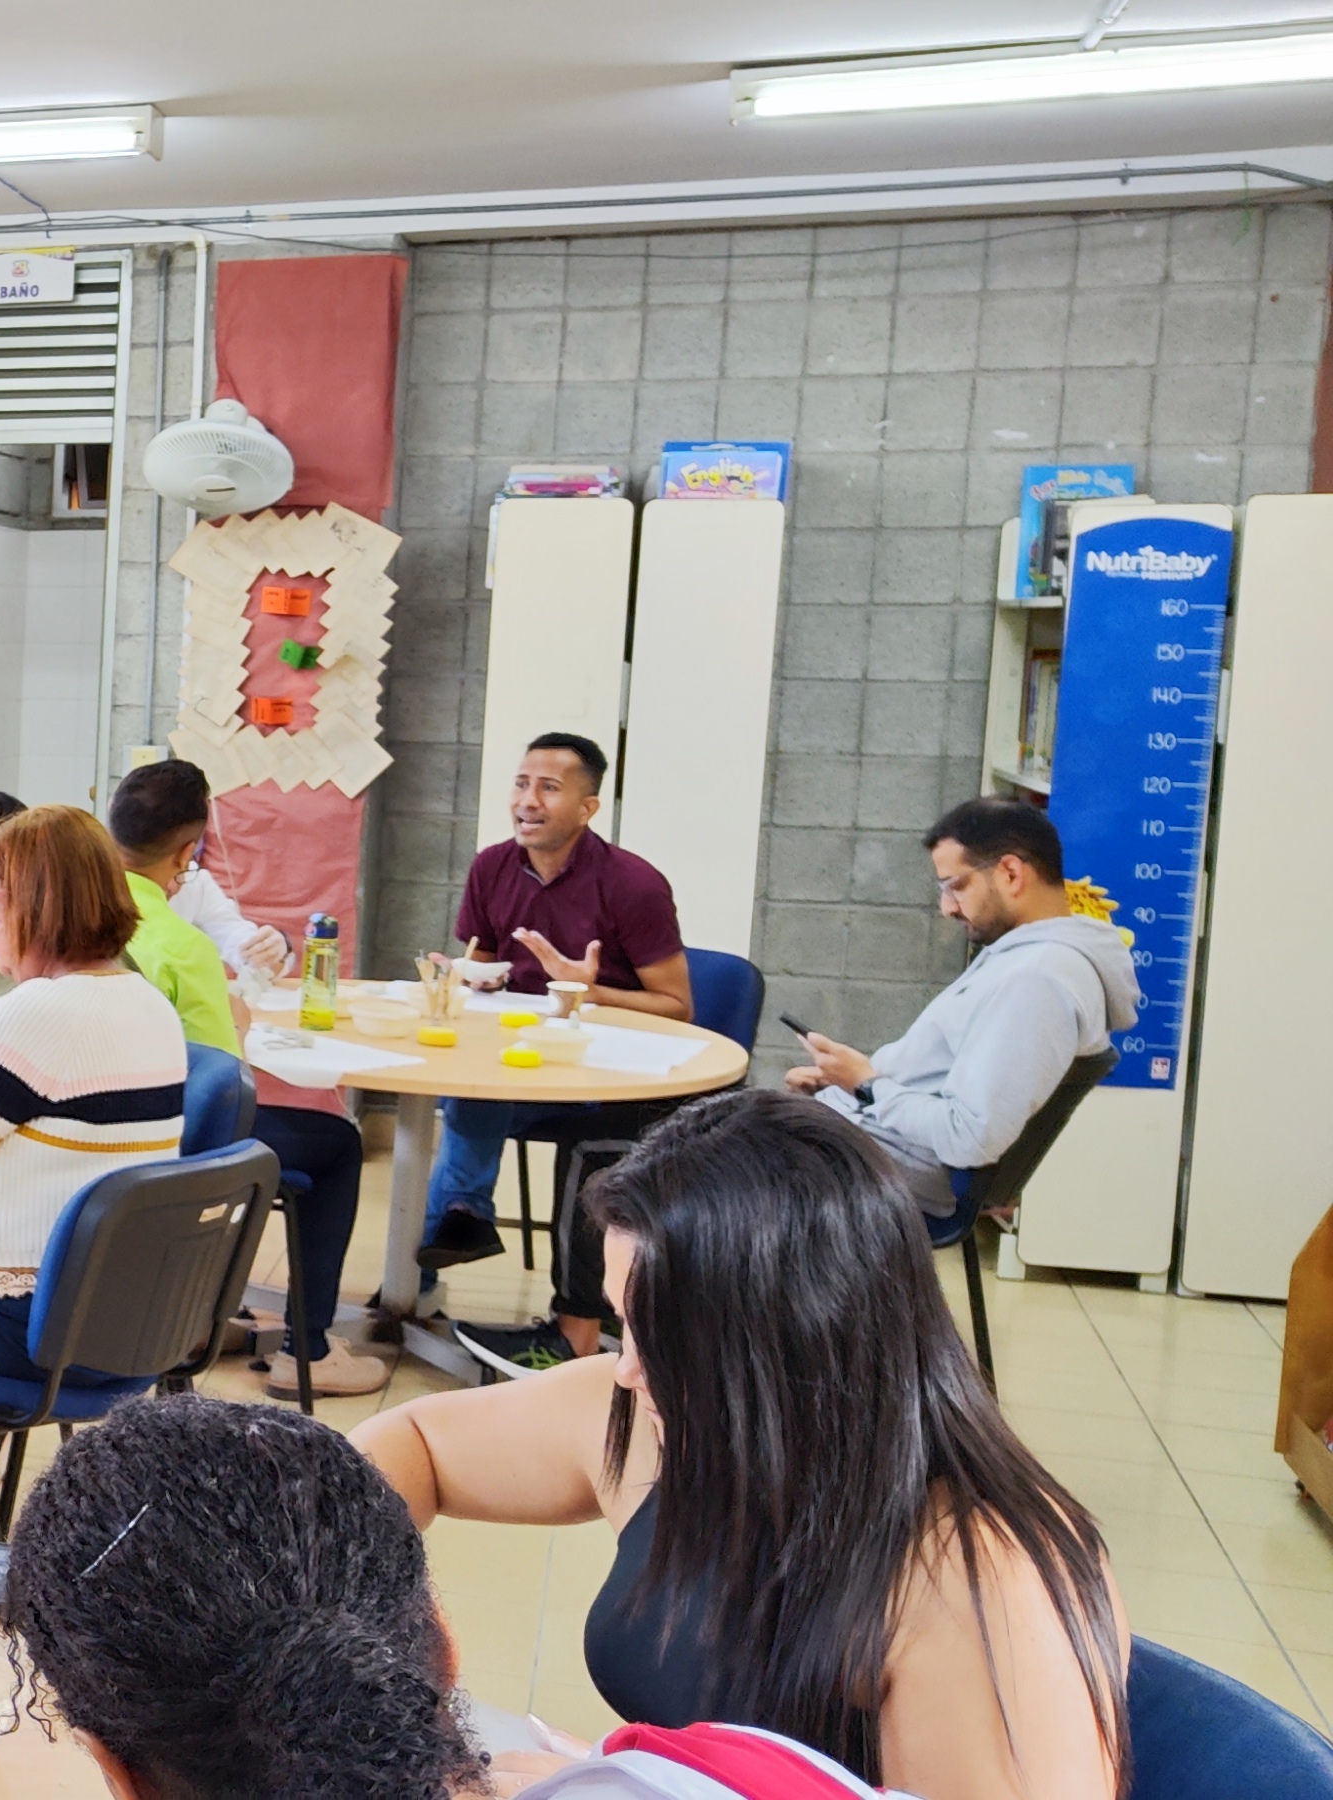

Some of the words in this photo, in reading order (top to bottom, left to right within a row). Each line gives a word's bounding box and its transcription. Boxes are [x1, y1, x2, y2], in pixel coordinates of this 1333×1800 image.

[0, 282, 39, 298] BAÑO
[680, 457, 756, 490] English
[1086, 547, 1212, 578] NutriBaby
[1160, 598, 1189, 617] 160
[1156, 643, 1185, 662] 150
[1151, 687, 1182, 705] 140
[1148, 732, 1177, 750] 130
[1143, 776, 1171, 795] 120
[1141, 819, 1165, 836] 110
[1134, 863, 1161, 880] 100
[1134, 907, 1156, 925] 90
[1122, 1036, 1146, 1054] 60
